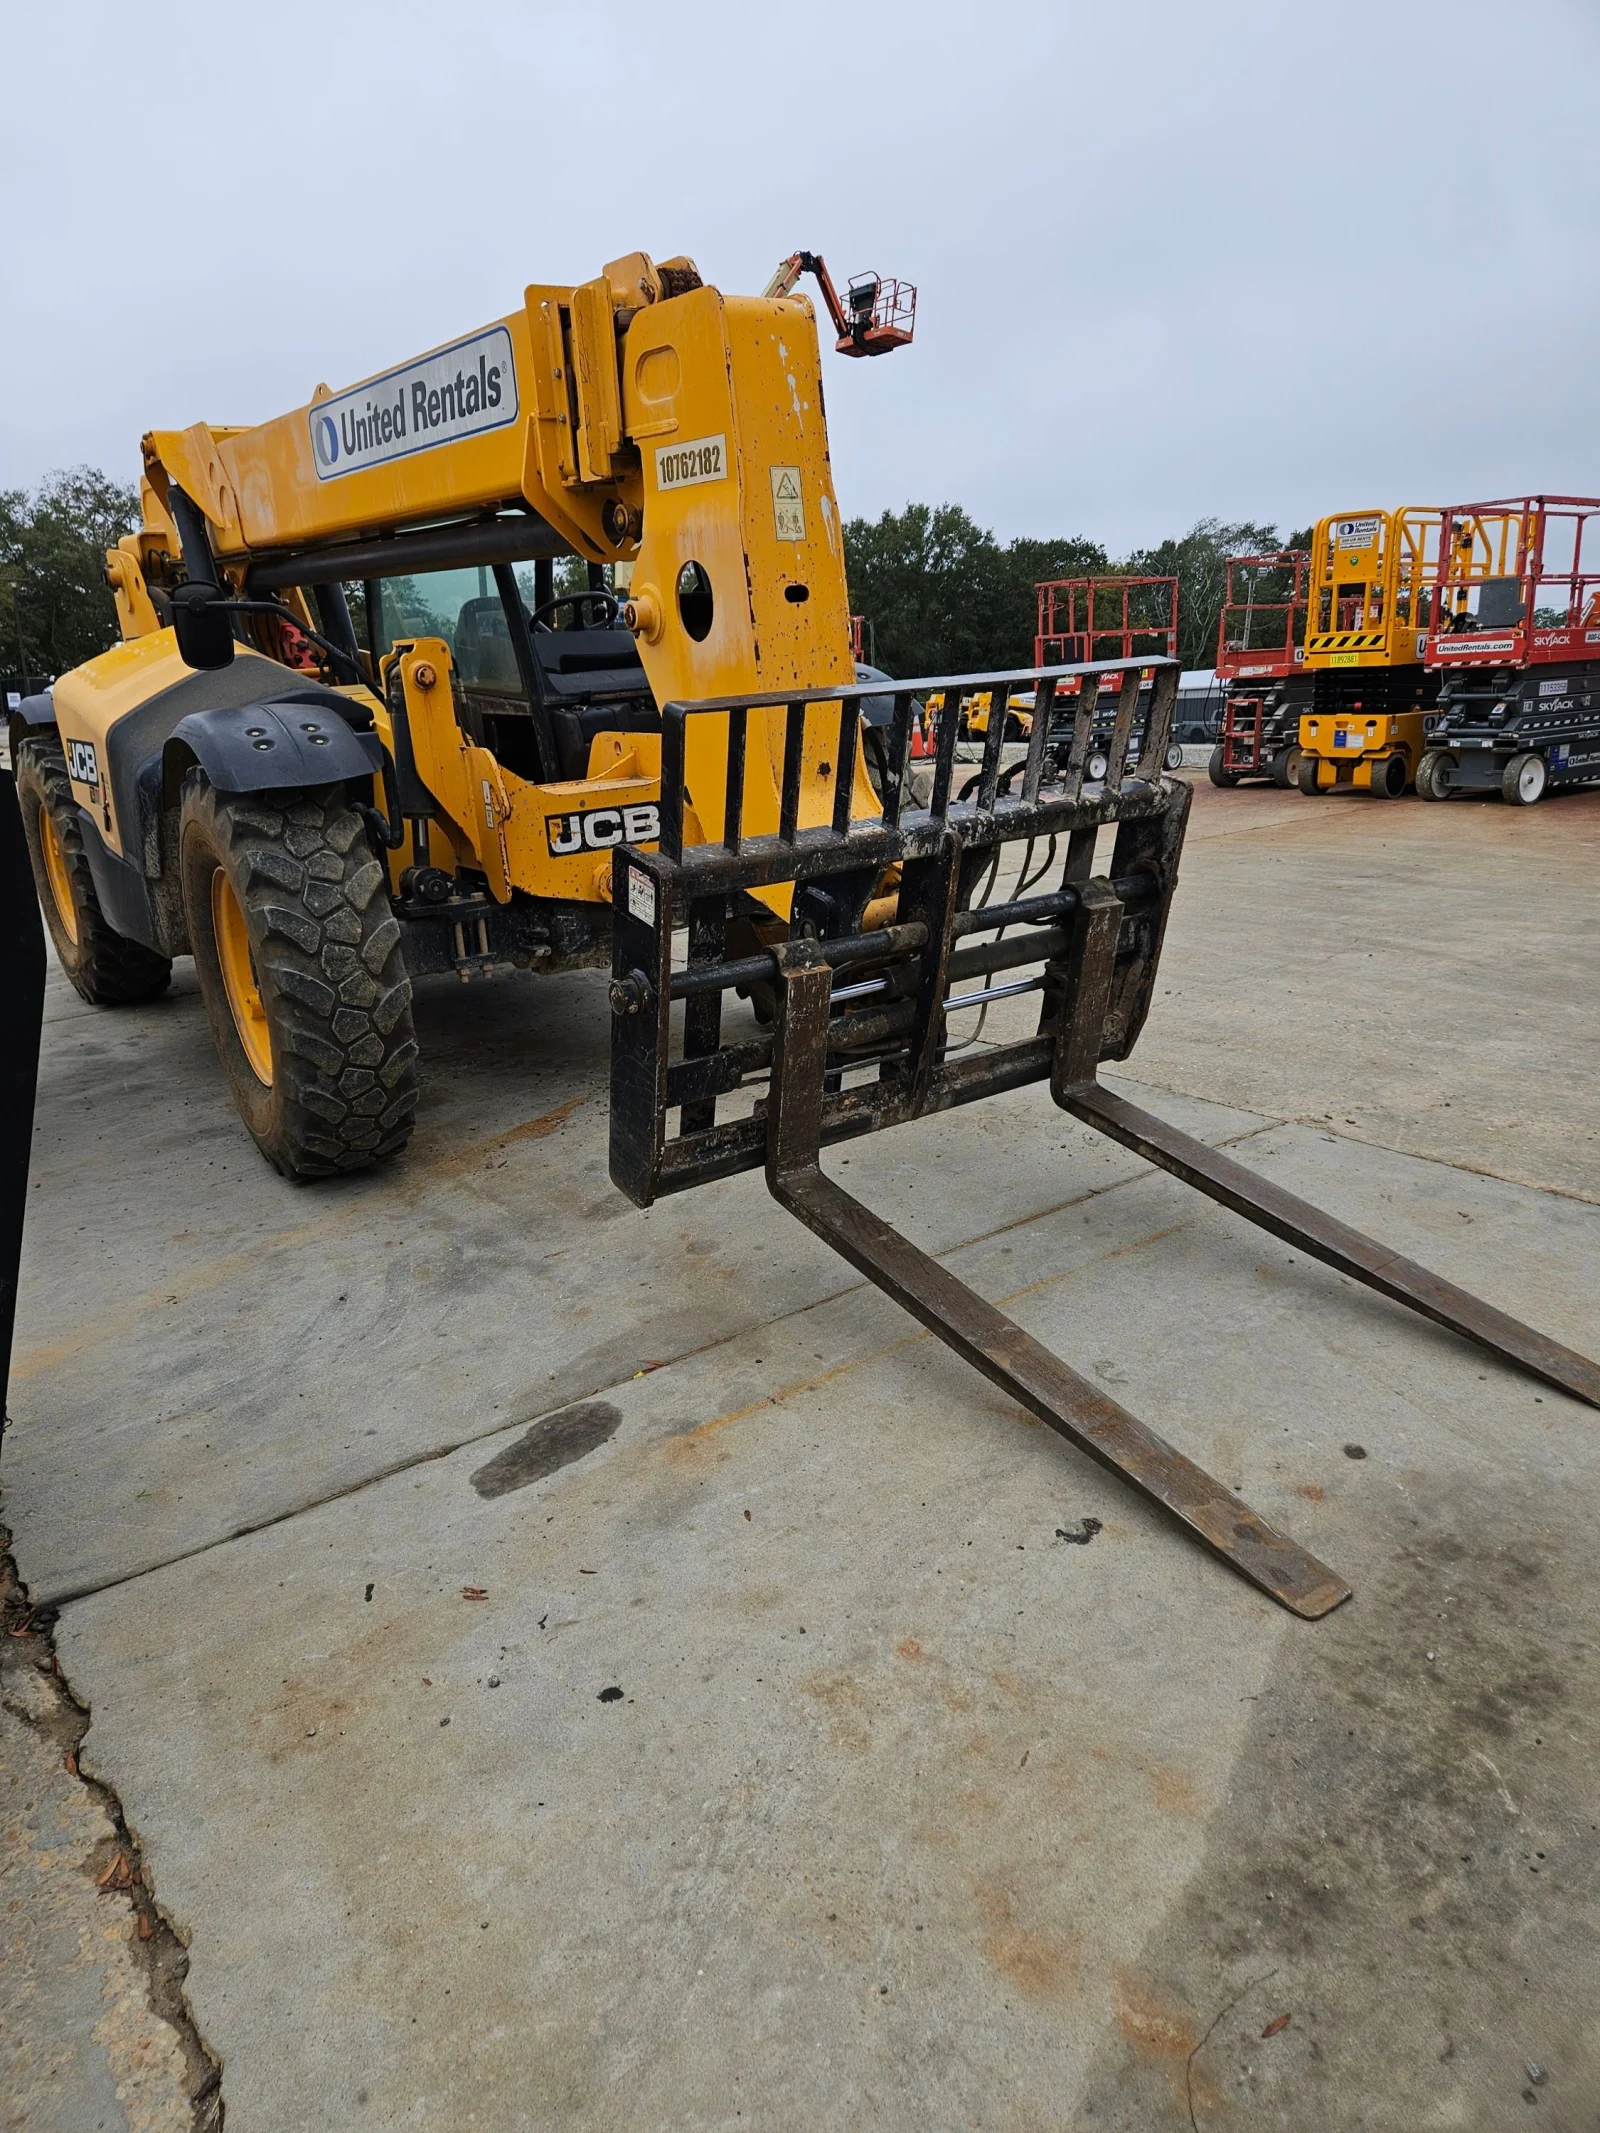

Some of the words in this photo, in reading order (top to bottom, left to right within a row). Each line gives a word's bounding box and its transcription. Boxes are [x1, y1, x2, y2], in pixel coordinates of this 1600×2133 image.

[341, 388, 406, 455] United
[411, 354, 501, 432] Rentals
[660, 445, 721, 483] 10762182
[1438, 642, 1512, 653] UnitedRentals.com
[1534, 632, 1570, 647] SKYJACK
[1331, 655, 1357, 664] 11892881
[1539, 698, 1573, 711] SKYJACK
[68, 742, 98, 783] JCB
[549, 805, 661, 853] JCB
